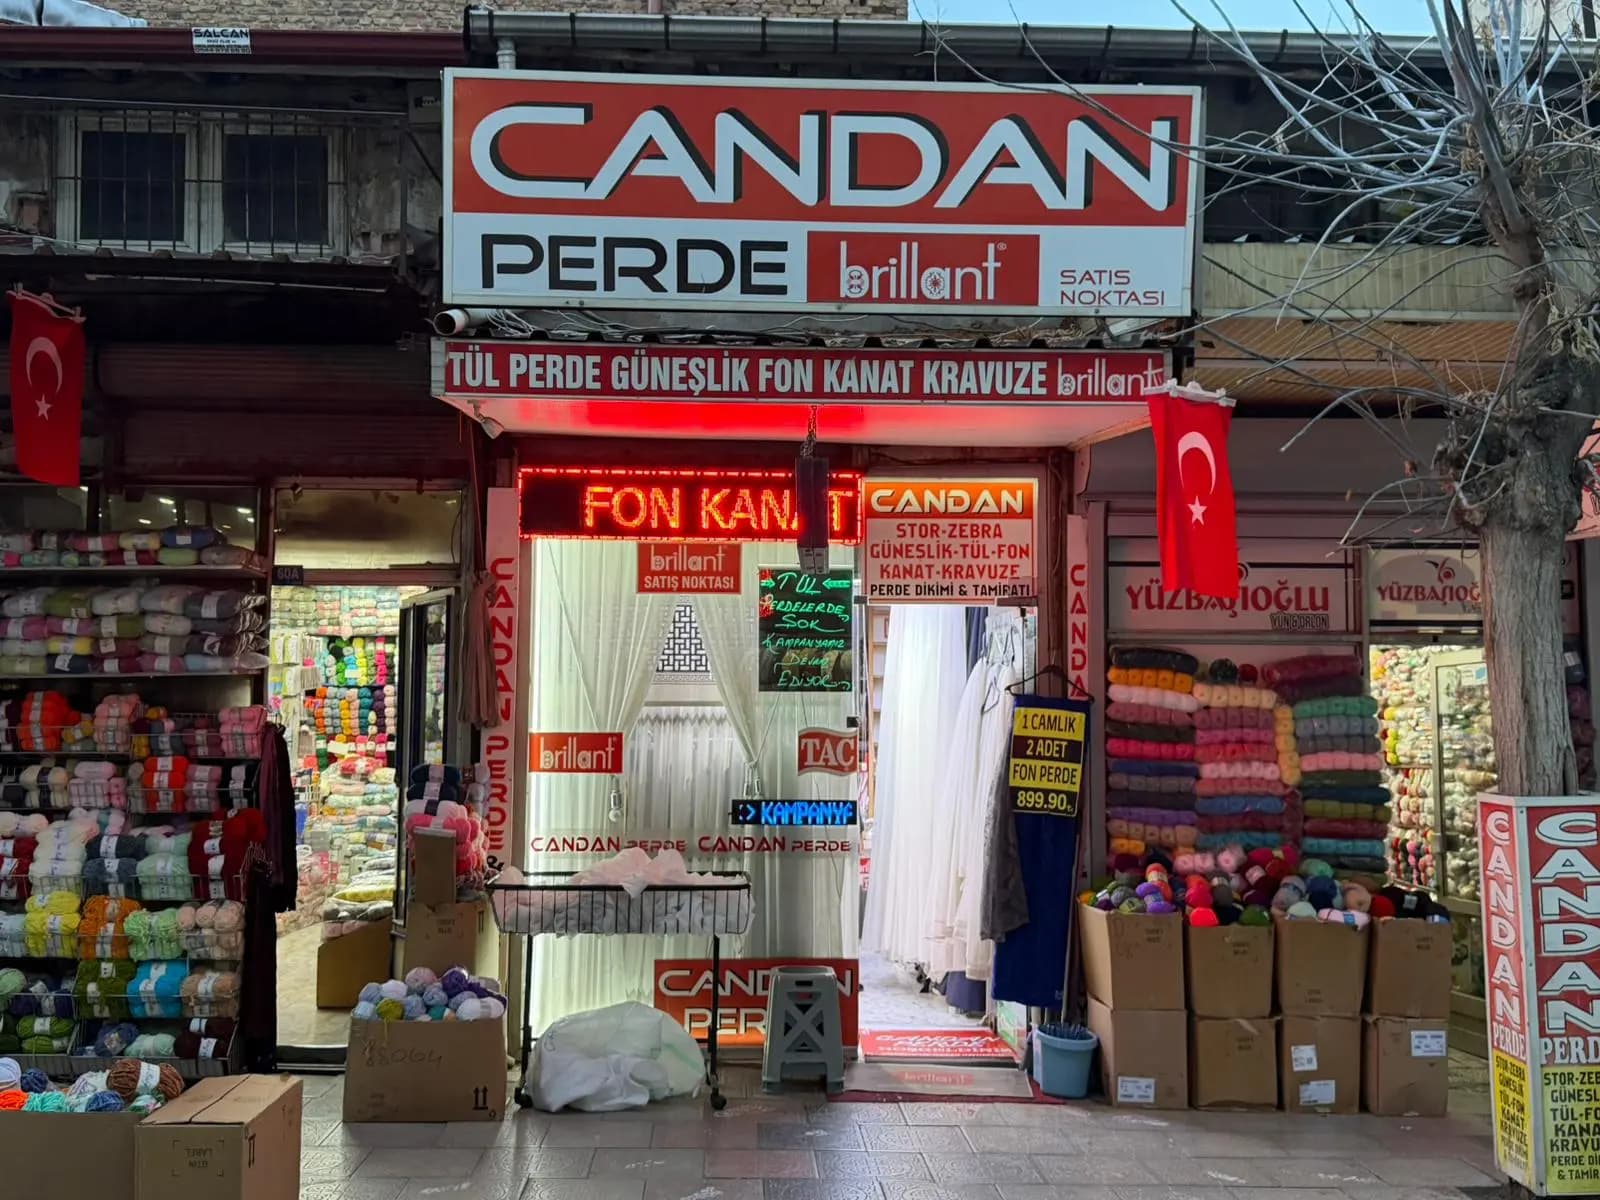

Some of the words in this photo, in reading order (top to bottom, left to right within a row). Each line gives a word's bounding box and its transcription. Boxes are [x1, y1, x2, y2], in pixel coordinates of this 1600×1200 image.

[470, 101, 1178, 212] CANDAN
[481, 233, 788, 296] PERDE
[1060, 290, 1165, 306] NOKTASI
[449, 345, 500, 388] TÜL
[509, 353, 600, 390] PERDE
[611, 349, 750, 397] GÜNEŞLİK
[759, 357, 813, 393] FON
[824, 358, 915, 395] KANAT
[923, 360, 1048, 396] KRAVUZE
[1057, 357, 1156, 397] brillant
[584, 485, 681, 529] FON
[701, 487, 854, 532] KANT
[870, 488, 1024, 514] CANDAN
[896, 523, 1003, 539] STOR-ZEBRA
[879, 563, 1021, 580] KANAT-KRAVUZE
[644, 575, 680, 592] SATIŞ
[681, 575, 735, 590] NOKTASI
[869, 584, 911, 597] PERDE
[915, 581, 955, 597] DİKİMİ
[958, 584, 968, 596] &
[1022, 714, 1029, 730] 1
[1026, 739, 1035, 756] 2
[1036, 739, 1068, 759] ADET
[1012, 763, 1037, 782] FON
[1039, 765, 1078, 786] PERDE
[531, 836, 621, 852] CANDAN
[699, 836, 786, 852] CANDAN
[792, 840, 851, 852] PERDE
[1485, 810, 1521, 1030] CANDAN
[1532, 812, 1600, 1034] CANDAN
[658, 969, 854, 999] CANN
[1492, 1021, 1527, 1061] PERDE
[1551, 1155, 1585, 1167] PERDE
[1588, 1152, 1600, 1166] Dİ
[1557, 1169, 1566, 1180] &
